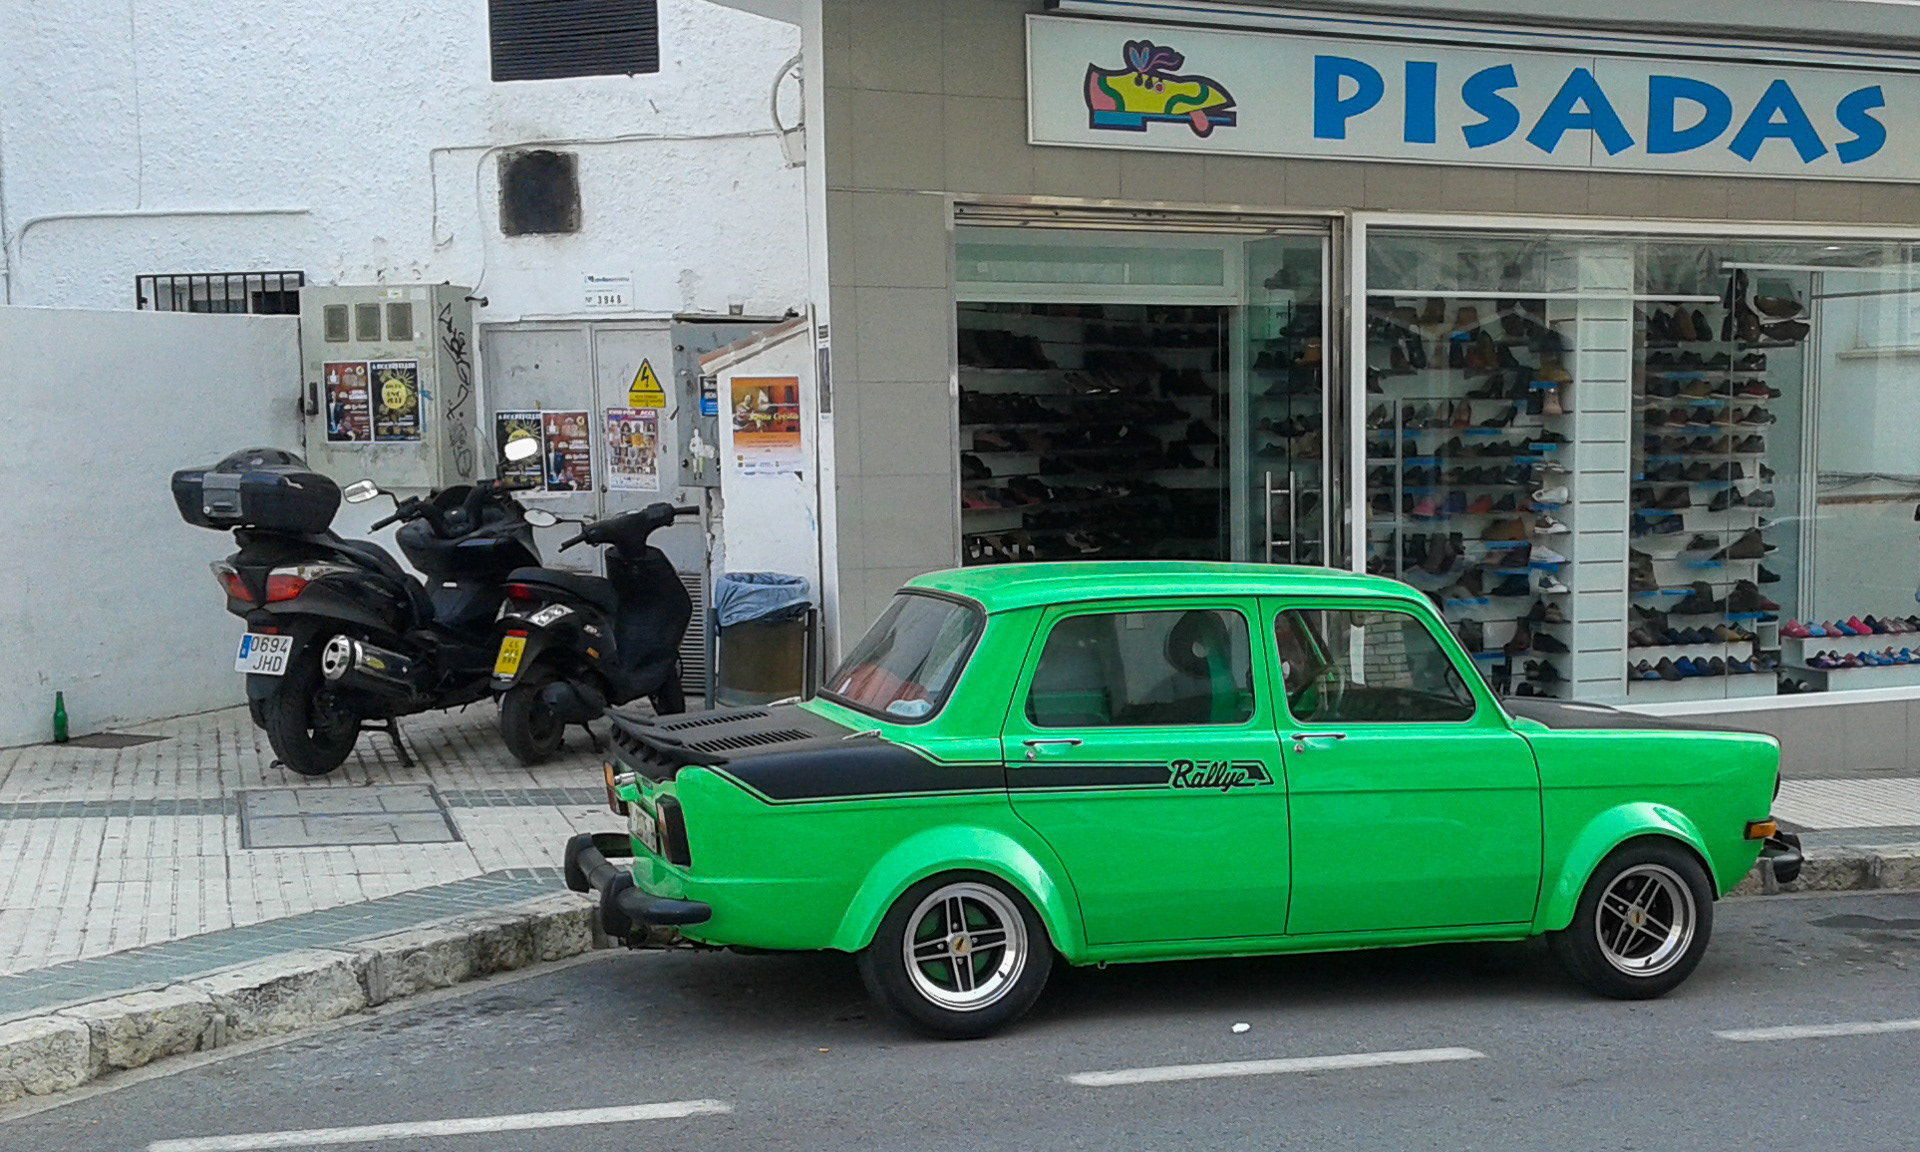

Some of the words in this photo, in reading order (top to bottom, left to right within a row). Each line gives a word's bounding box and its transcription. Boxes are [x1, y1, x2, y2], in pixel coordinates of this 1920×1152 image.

[1313, 55, 1888, 165] PISADAS
[250, 636, 288, 654] 0694
[252, 654, 283, 672] JHD
[1170, 759, 1256, 793] Rallye
